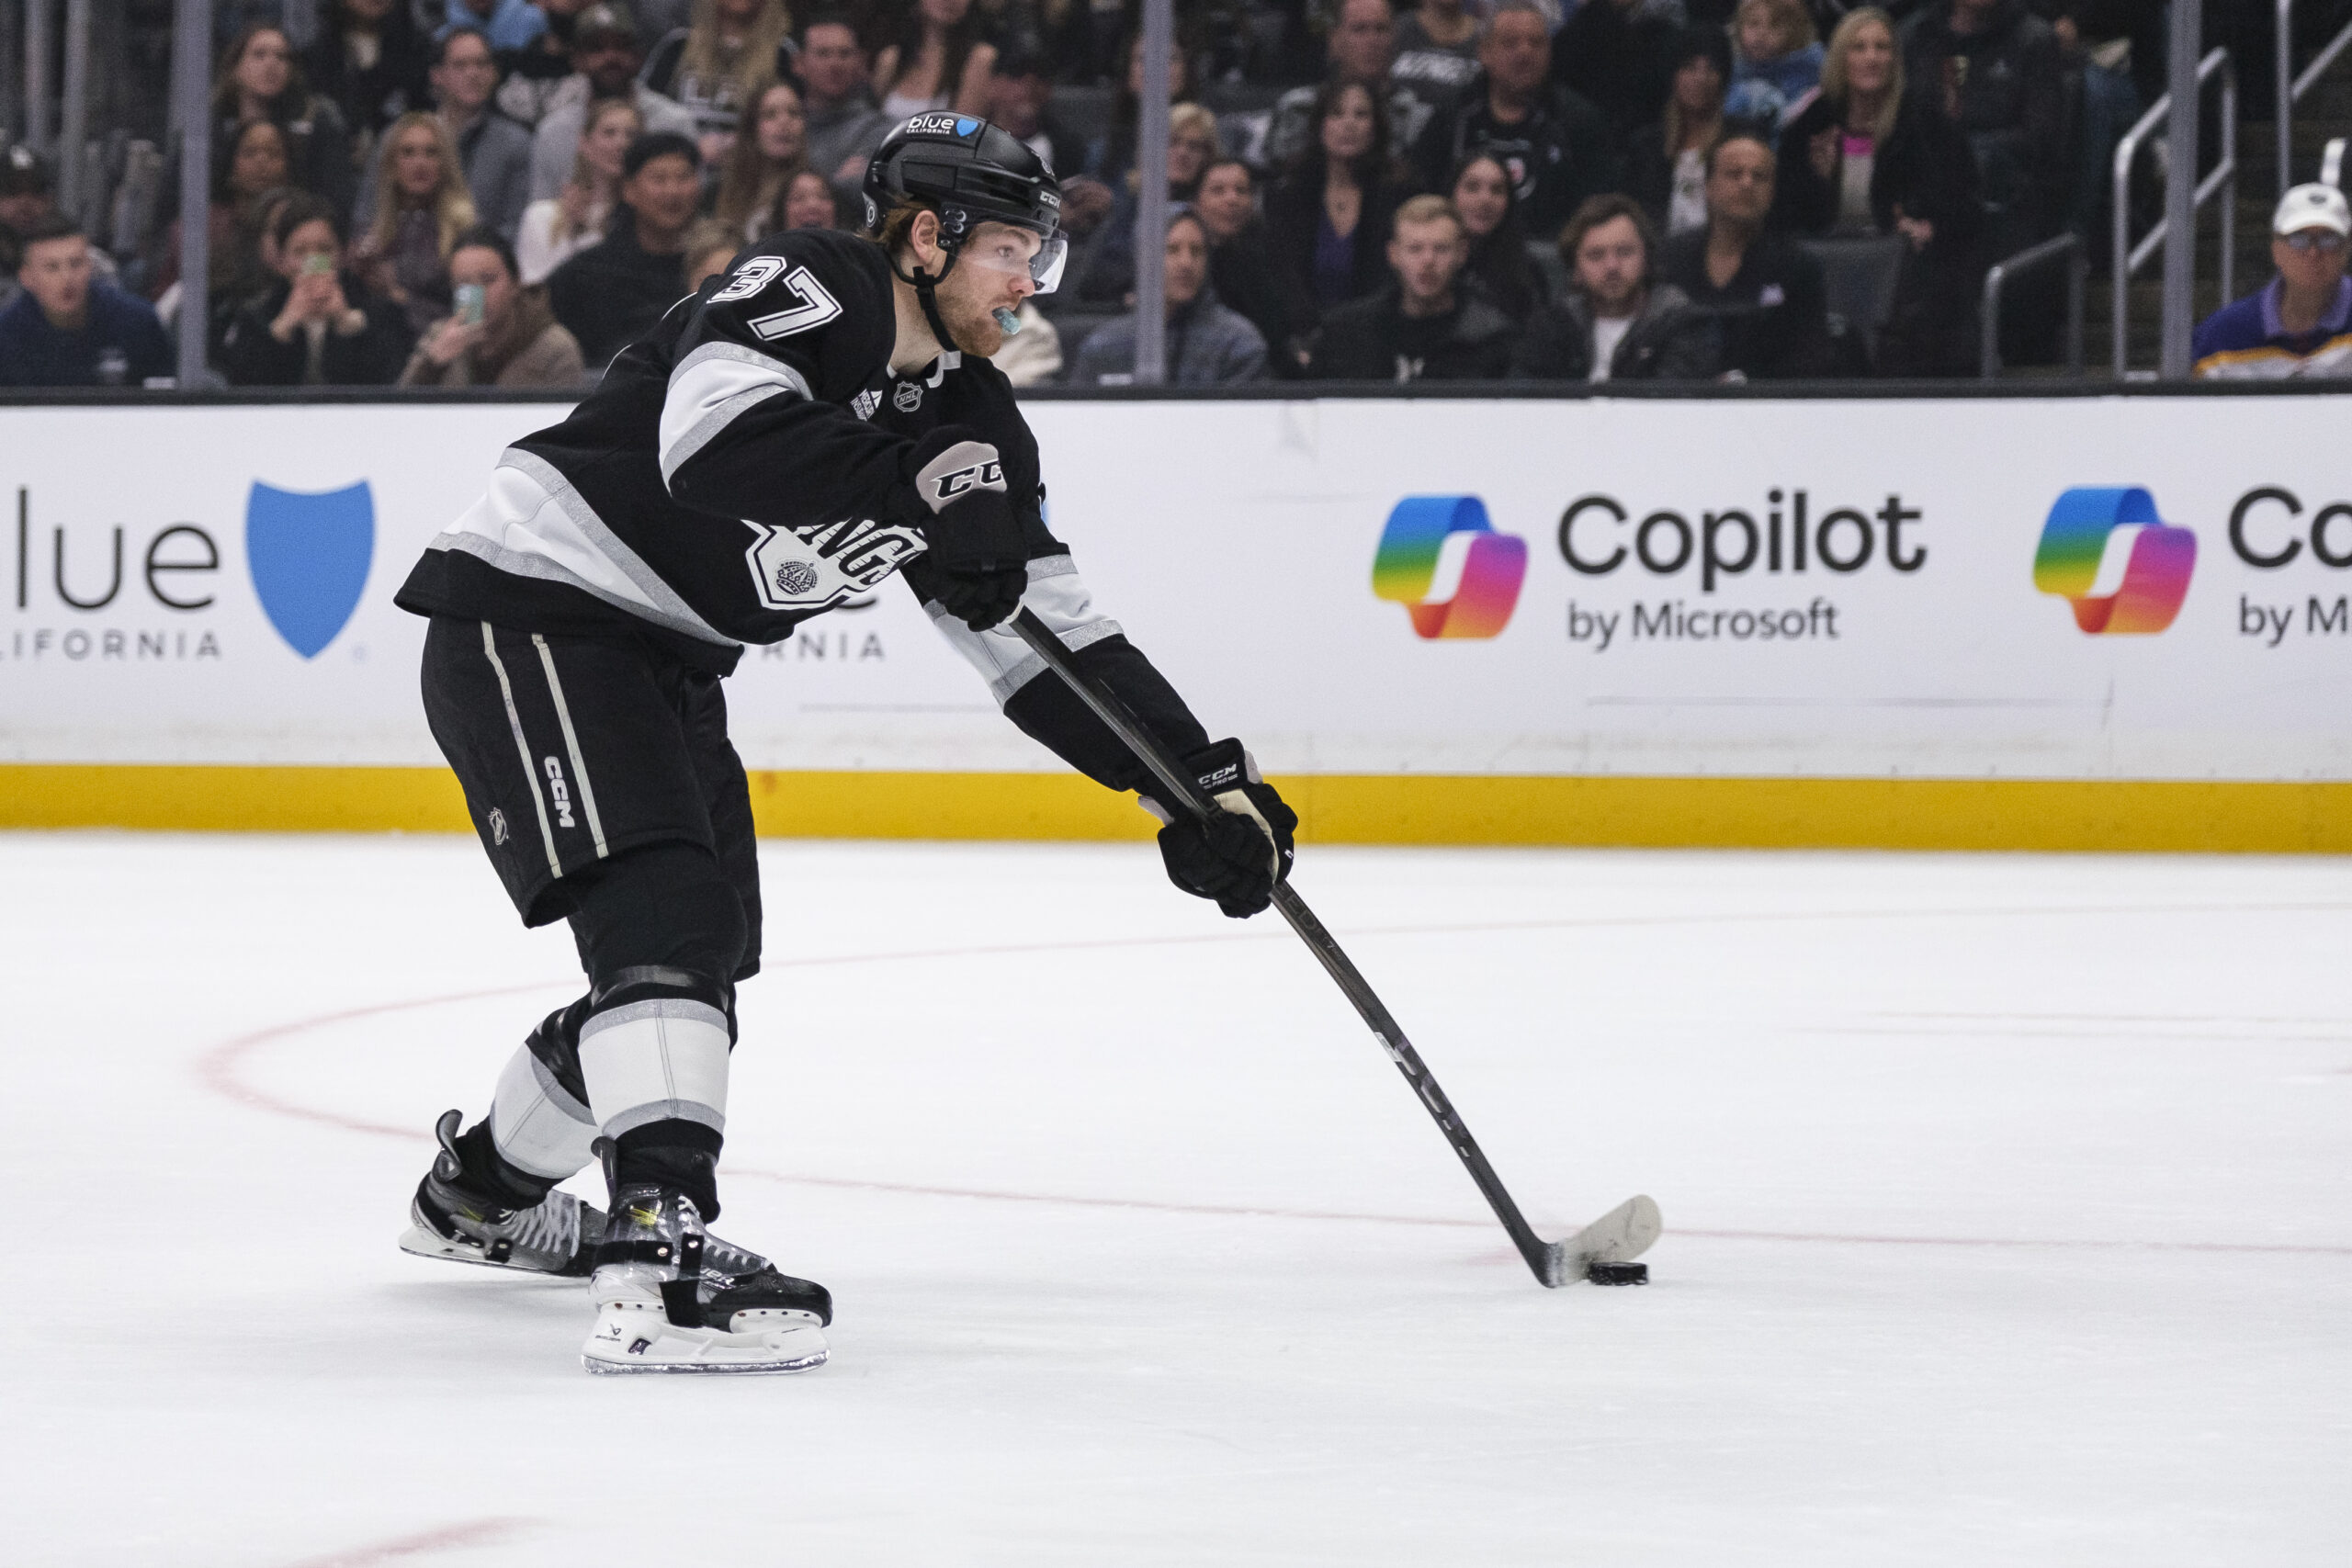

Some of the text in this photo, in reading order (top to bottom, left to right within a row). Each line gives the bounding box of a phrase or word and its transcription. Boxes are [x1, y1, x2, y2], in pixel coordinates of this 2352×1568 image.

[908, 115, 955, 130] blue
[706, 255, 843, 342] 37
[930, 458, 1004, 500] CC
[16, 487, 220, 612] lue
[1557, 487, 1928, 594] Copilot
[13, 629, 221, 660] IFORNIA
[1568, 596, 1839, 652] by Microsoft
[2239, 594, 2293, 649] by
[544, 756, 575, 828] CCM
[1198, 763, 1237, 784] CCM
